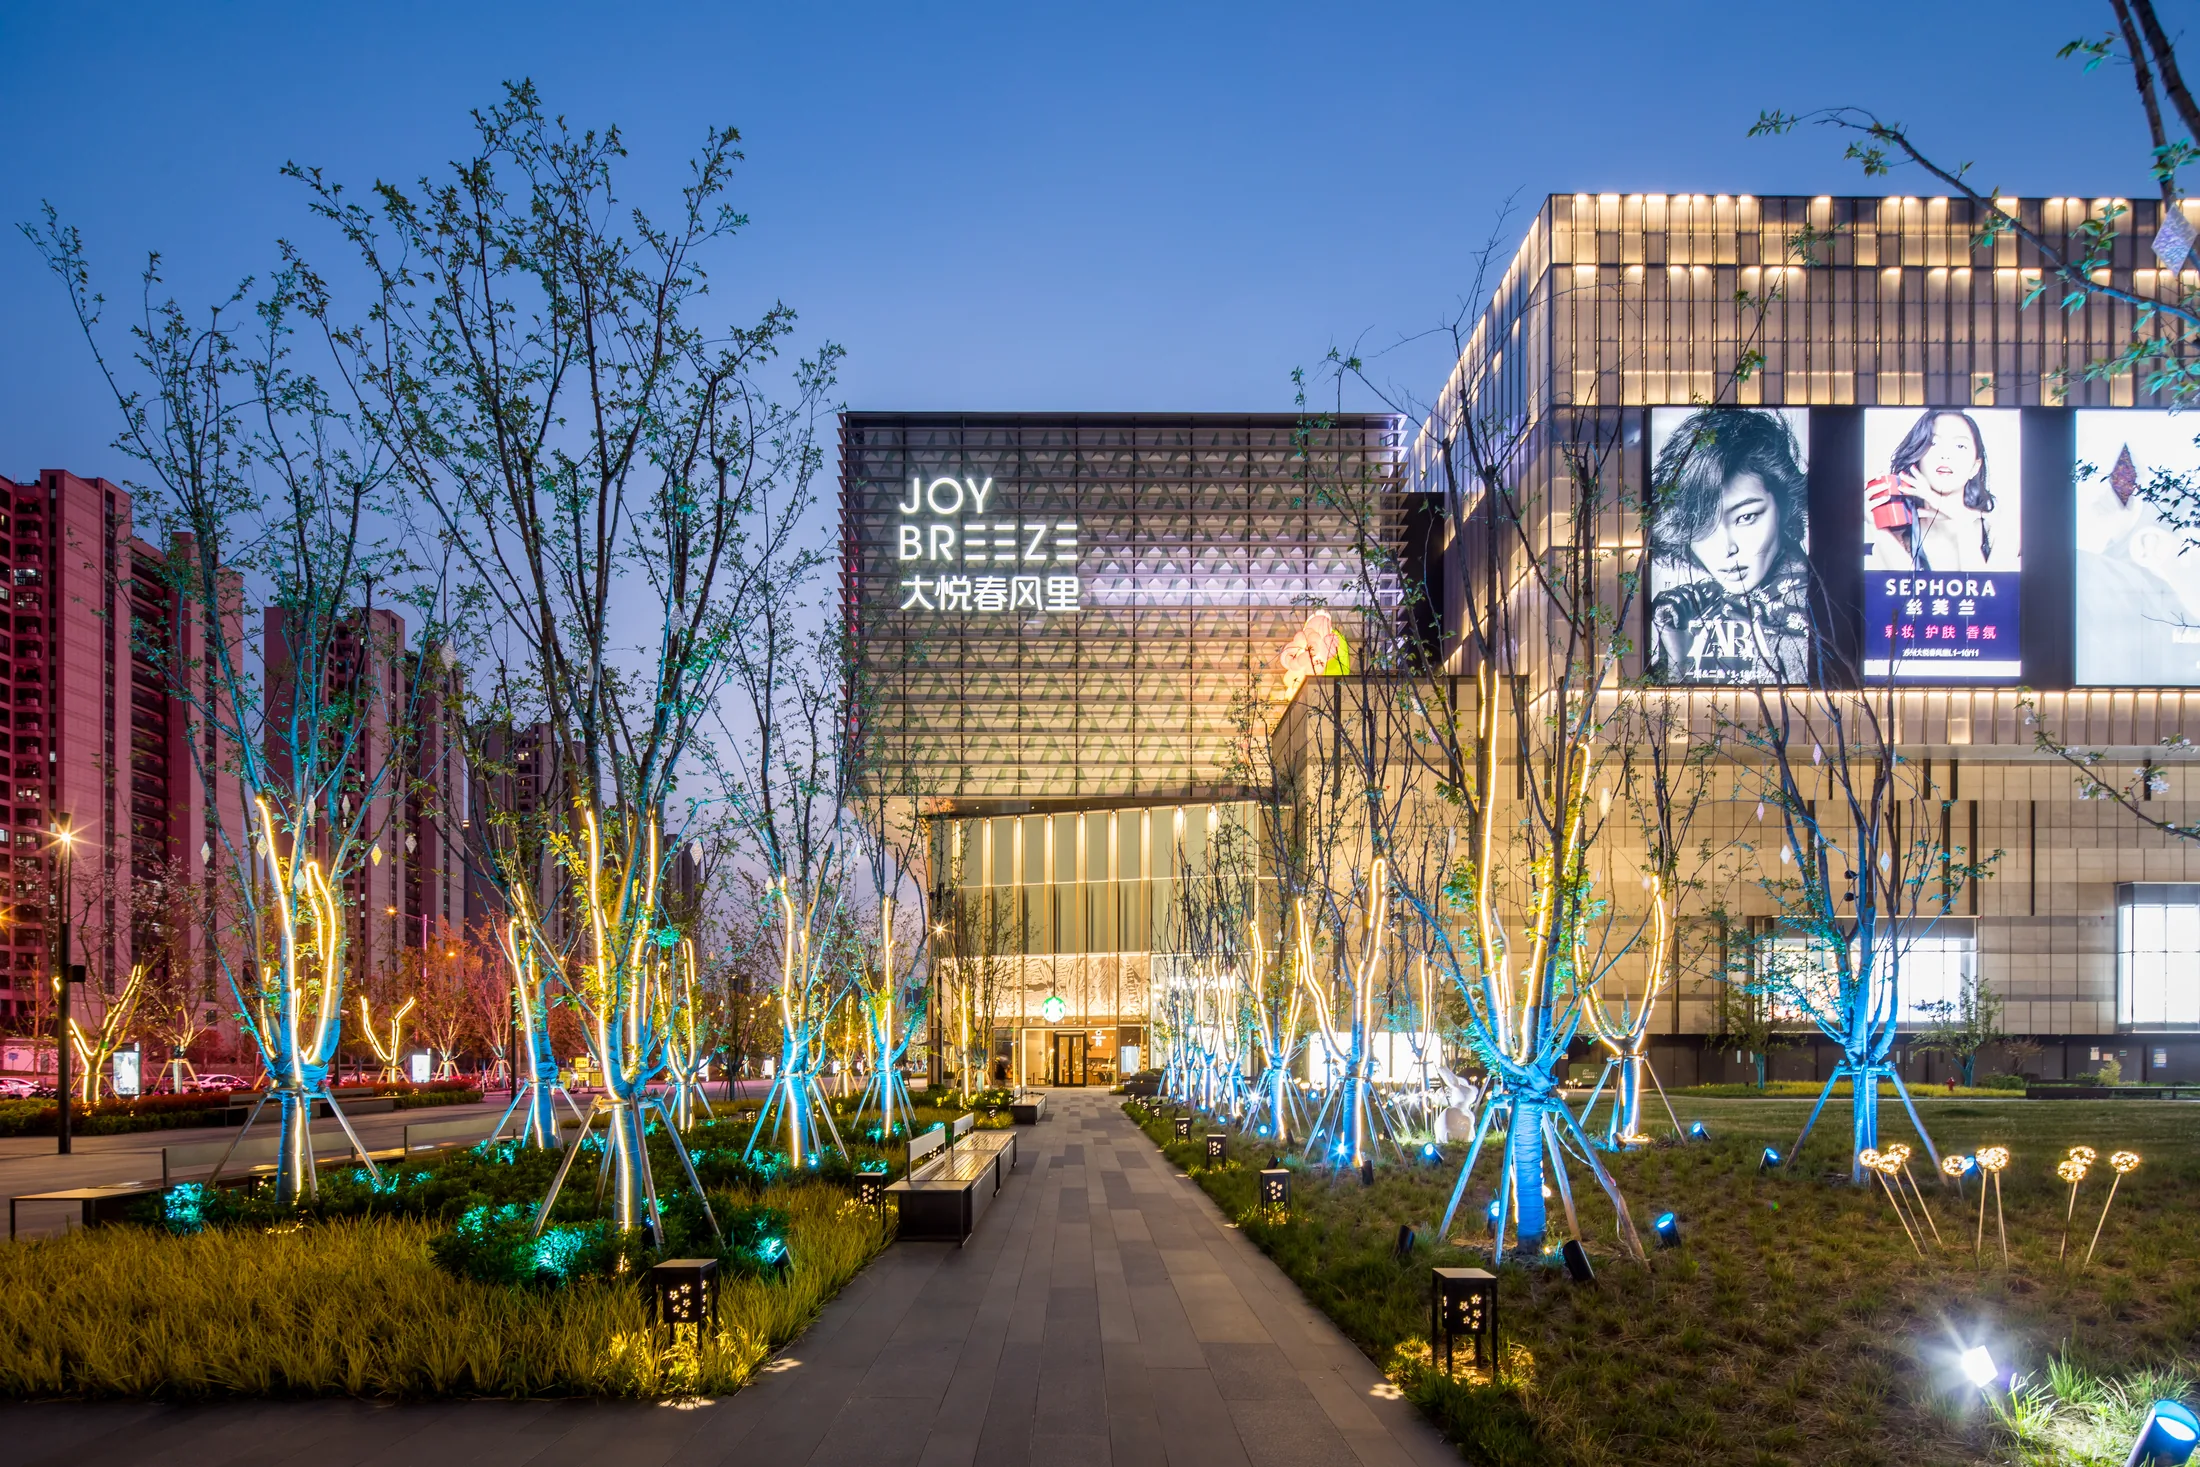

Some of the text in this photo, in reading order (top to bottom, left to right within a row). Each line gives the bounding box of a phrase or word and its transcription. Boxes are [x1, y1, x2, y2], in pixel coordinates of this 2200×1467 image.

[899, 477, 992, 514] JOY
[899, 524, 1078, 561] BREEZE
[900, 574, 1081, 611] 大悦春风里
[1885, 578, 1996, 597] SEPHORA
[1905, 598, 1976, 616] 丝芙兰
[1687, 620, 1772, 658] ZARA
[1925, 624, 1956, 639] 护肤
[1966, 625, 1997, 640] 香氛
